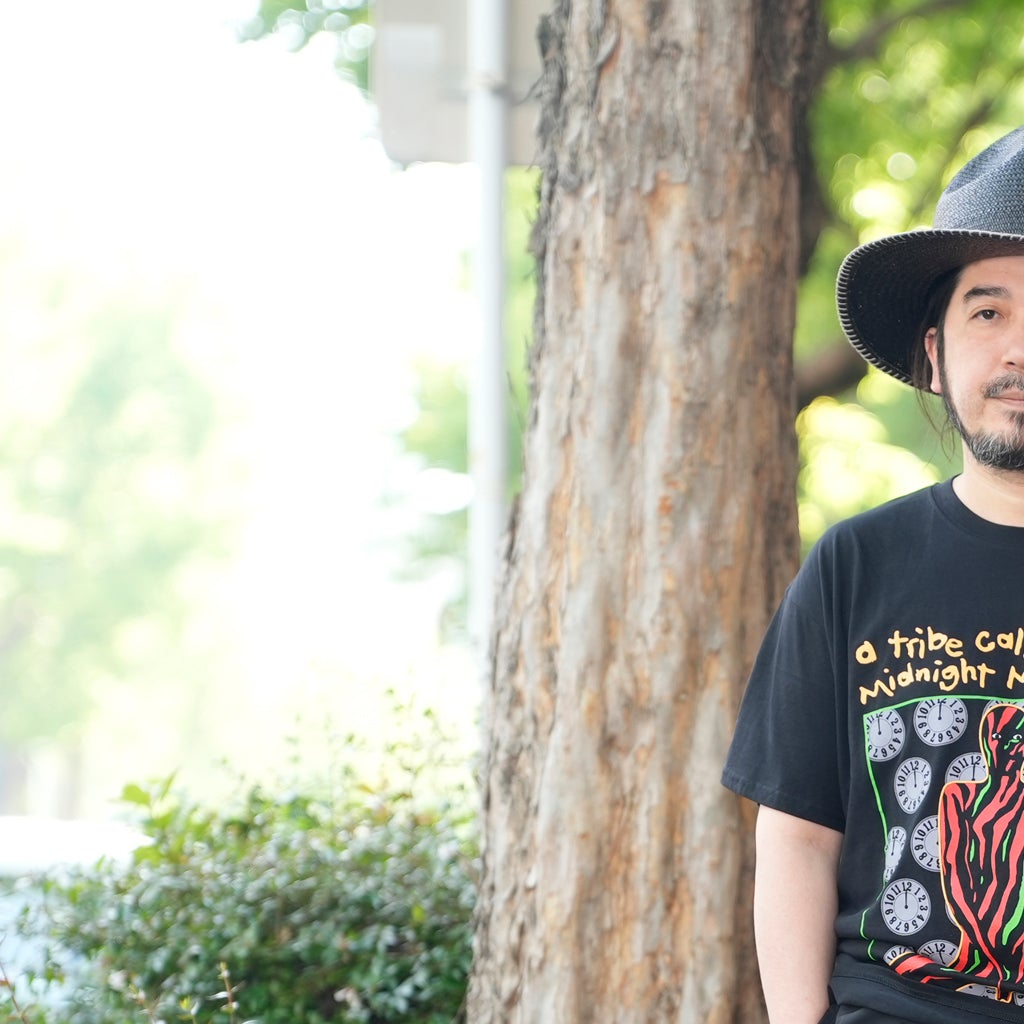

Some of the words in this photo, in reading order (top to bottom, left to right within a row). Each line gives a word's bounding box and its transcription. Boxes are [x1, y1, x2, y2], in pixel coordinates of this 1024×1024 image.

[855, 641, 878, 665] a
[888, 627, 964, 659] tribe
[859, 657, 996, 705] Midnight
